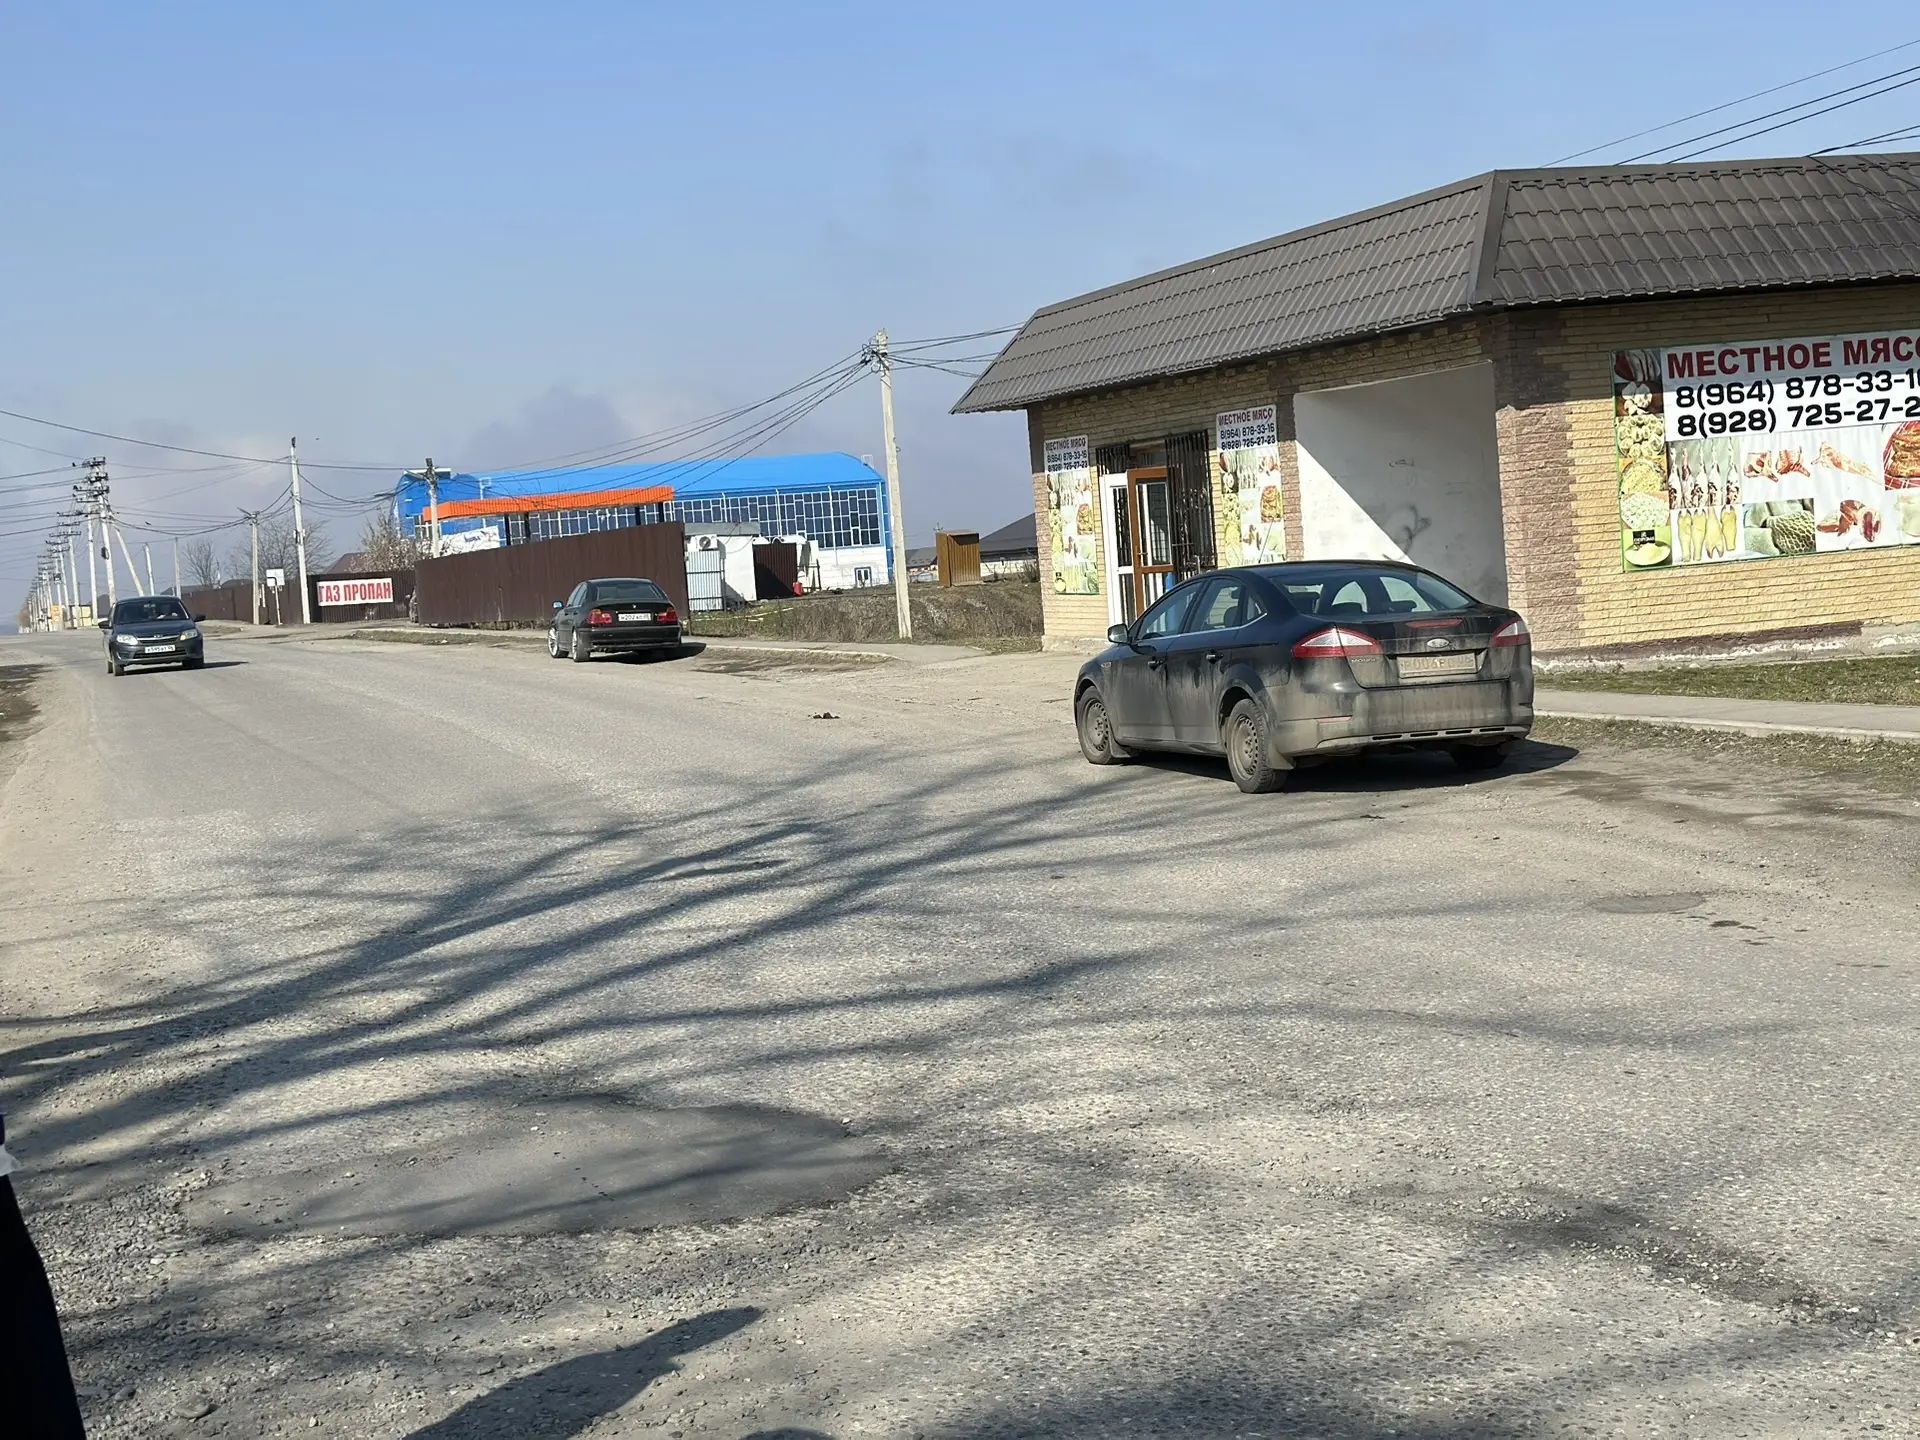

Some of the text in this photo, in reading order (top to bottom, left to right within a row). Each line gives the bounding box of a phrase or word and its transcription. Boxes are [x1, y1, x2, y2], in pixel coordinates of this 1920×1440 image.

[1667, 335, 1920, 379] МЕСТНОЕ МЯС
[1675, 367, 1920, 410] 8(964) 878-33-1
[1218, 407, 1273, 426] МЕСТНОЕ МЯСО
[1677, 406, 1777, 439] 8(928)
[318, 582, 391, 602] ГАЗ ПРОПАН
